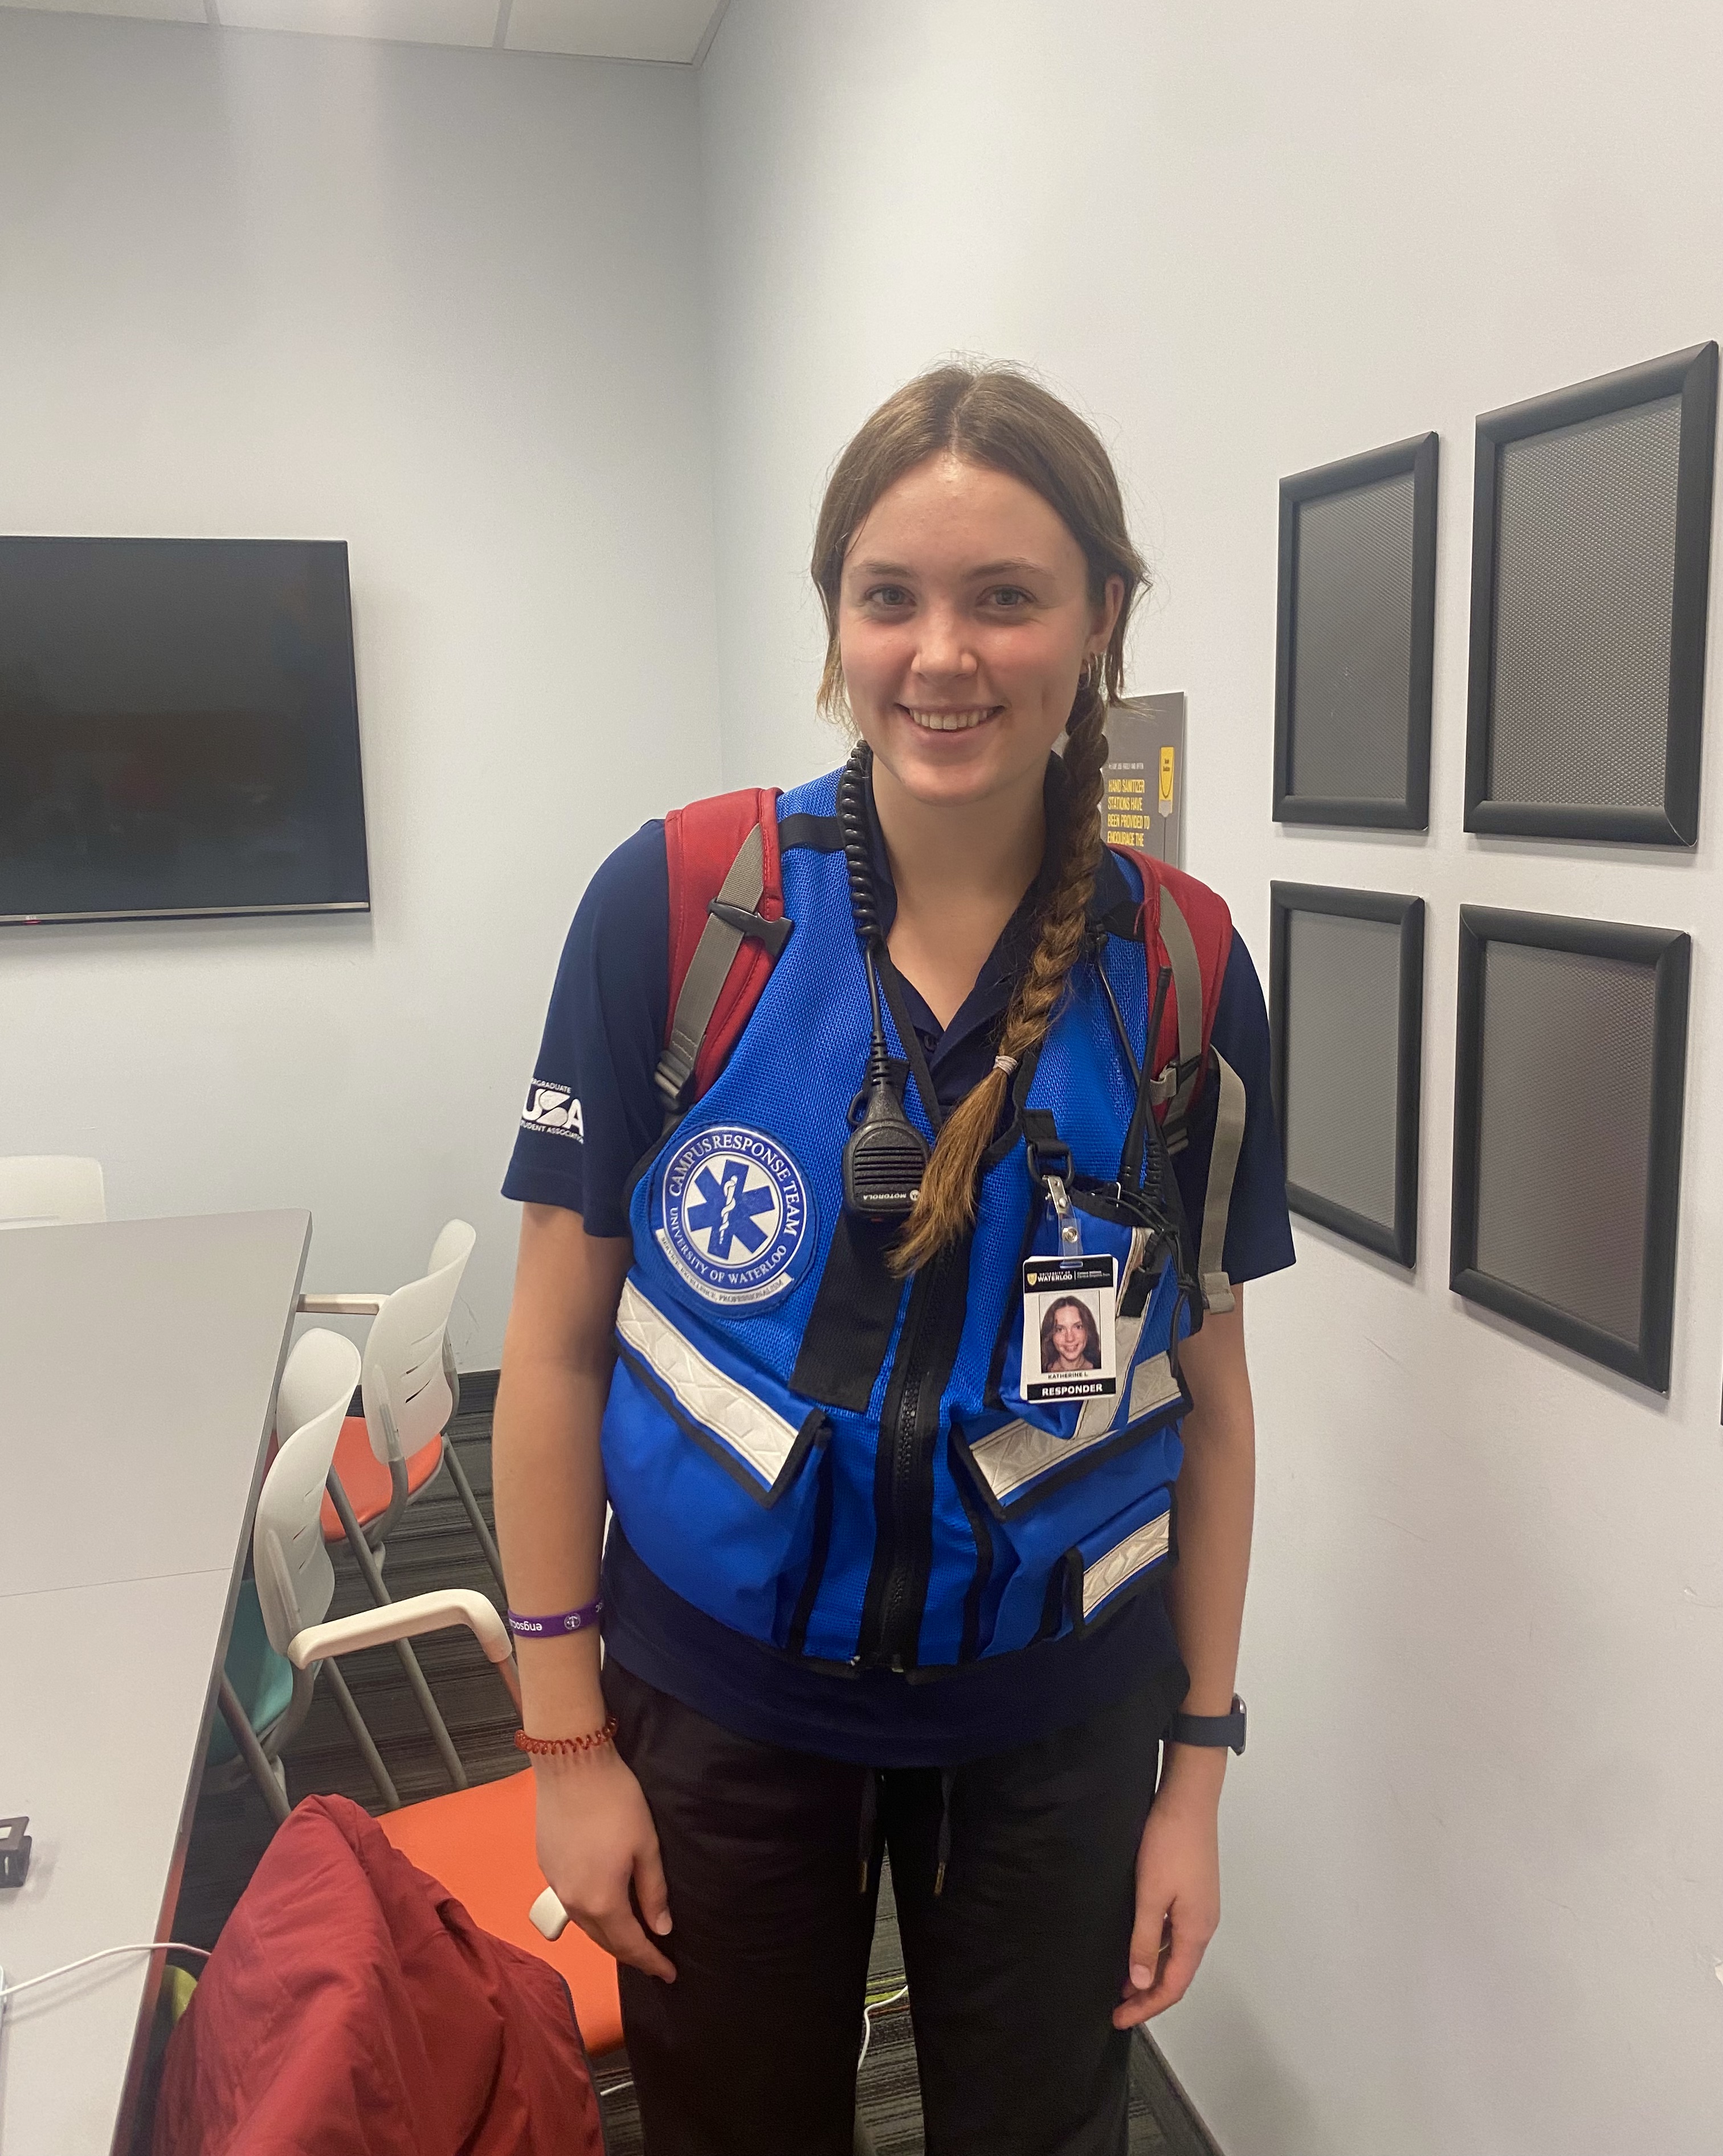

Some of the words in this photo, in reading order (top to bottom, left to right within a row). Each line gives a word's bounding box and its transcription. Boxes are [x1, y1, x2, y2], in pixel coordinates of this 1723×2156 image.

[1108, 779, 1121, 793] HAND
[1122, 779, 1145, 794] SANITIZER
[1108, 797, 1130, 810] STATIONS
[1130, 797, 1143, 811] HAVE
[1108, 814, 1120, 827] BEEN
[1121, 815, 1143, 829] PROVIDED
[1144, 815, 1150, 830] TO
[1107, 831, 1134, 846] ENCOURAGE
[1136, 832, 1144, 847] THE
[669, 1138, 712, 1197] CAMPUS
[712, 1134, 790, 1182] RESPONSE
[783, 1179, 801, 1236] TEAM
[670, 1206, 708, 1275] UNIVERSITY
[709, 1269, 725, 1283] OF
[728, 1245, 787, 1284] WATERLOO
[1037, 1273, 1073, 1282] WATERLOO
[1042, 1383, 1103, 1396] RESPONDER
